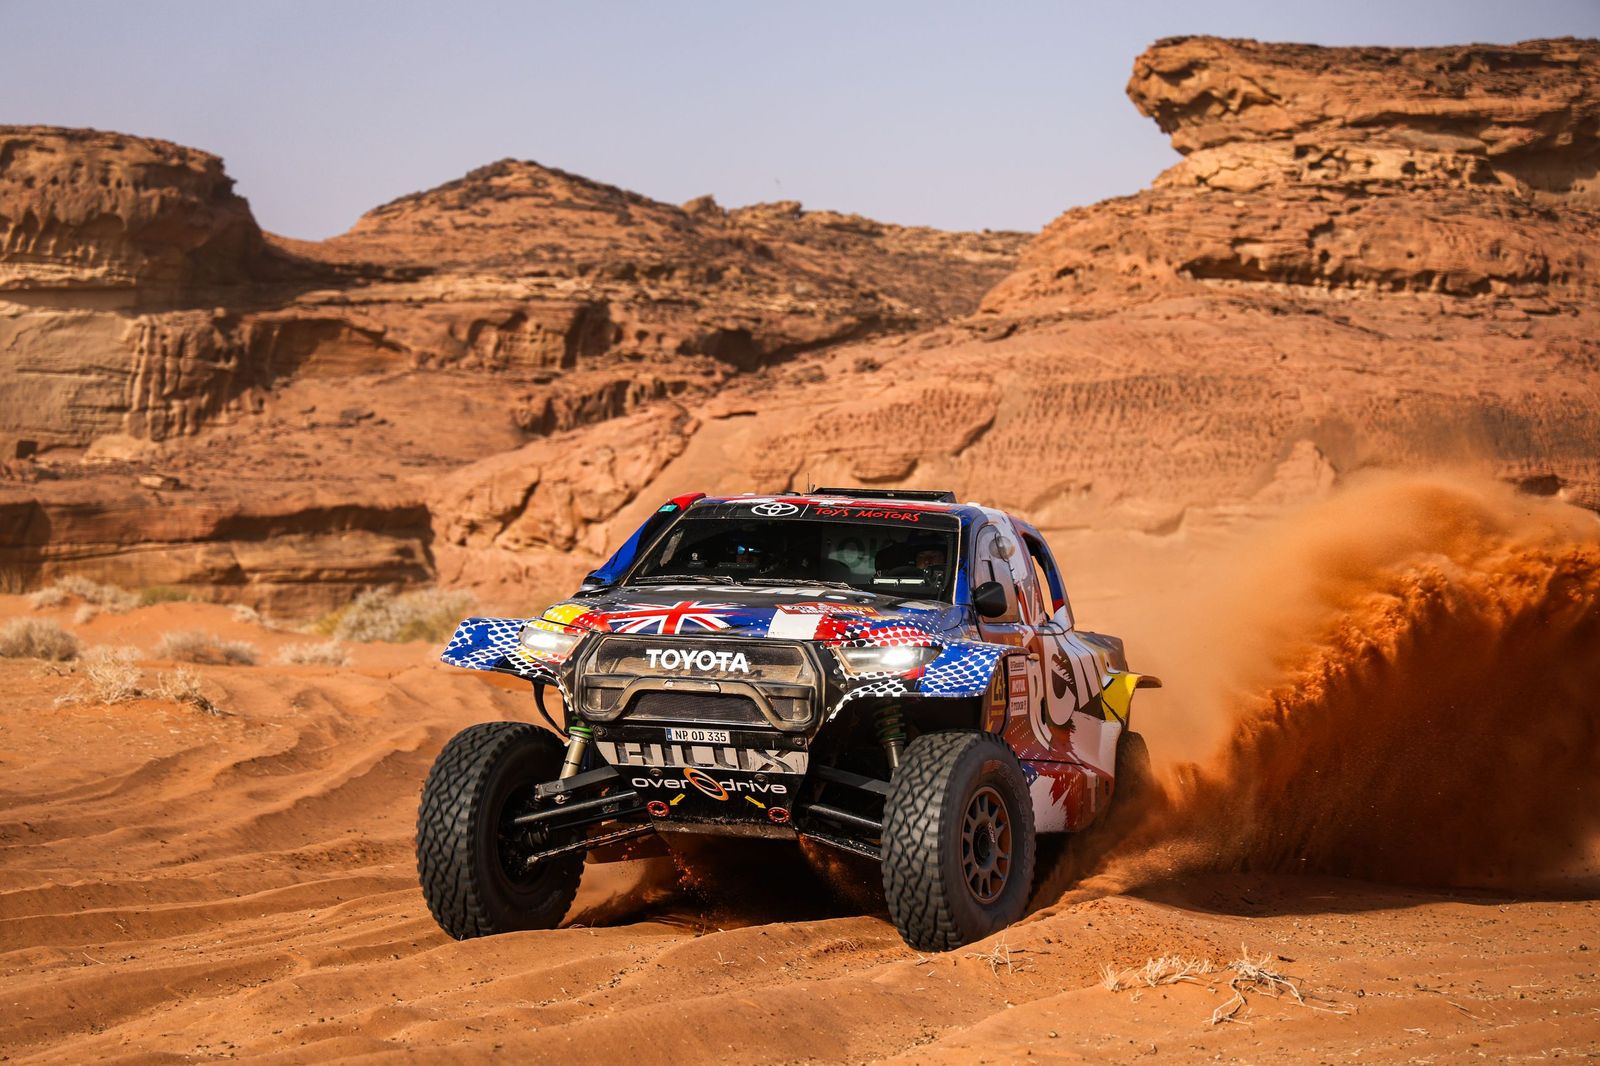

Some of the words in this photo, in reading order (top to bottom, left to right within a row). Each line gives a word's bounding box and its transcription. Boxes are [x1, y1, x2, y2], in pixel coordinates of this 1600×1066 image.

[813, 507, 849, 517] TOYS
[855, 509, 920, 522] MOTORS
[645, 648, 750, 673] TOYOTA
[674, 730, 689, 741] NP
[691, 731, 705, 741] OD
[707, 732, 727, 742] 335
[631, 777, 690, 789] over
[718, 778, 788, 794] drive
